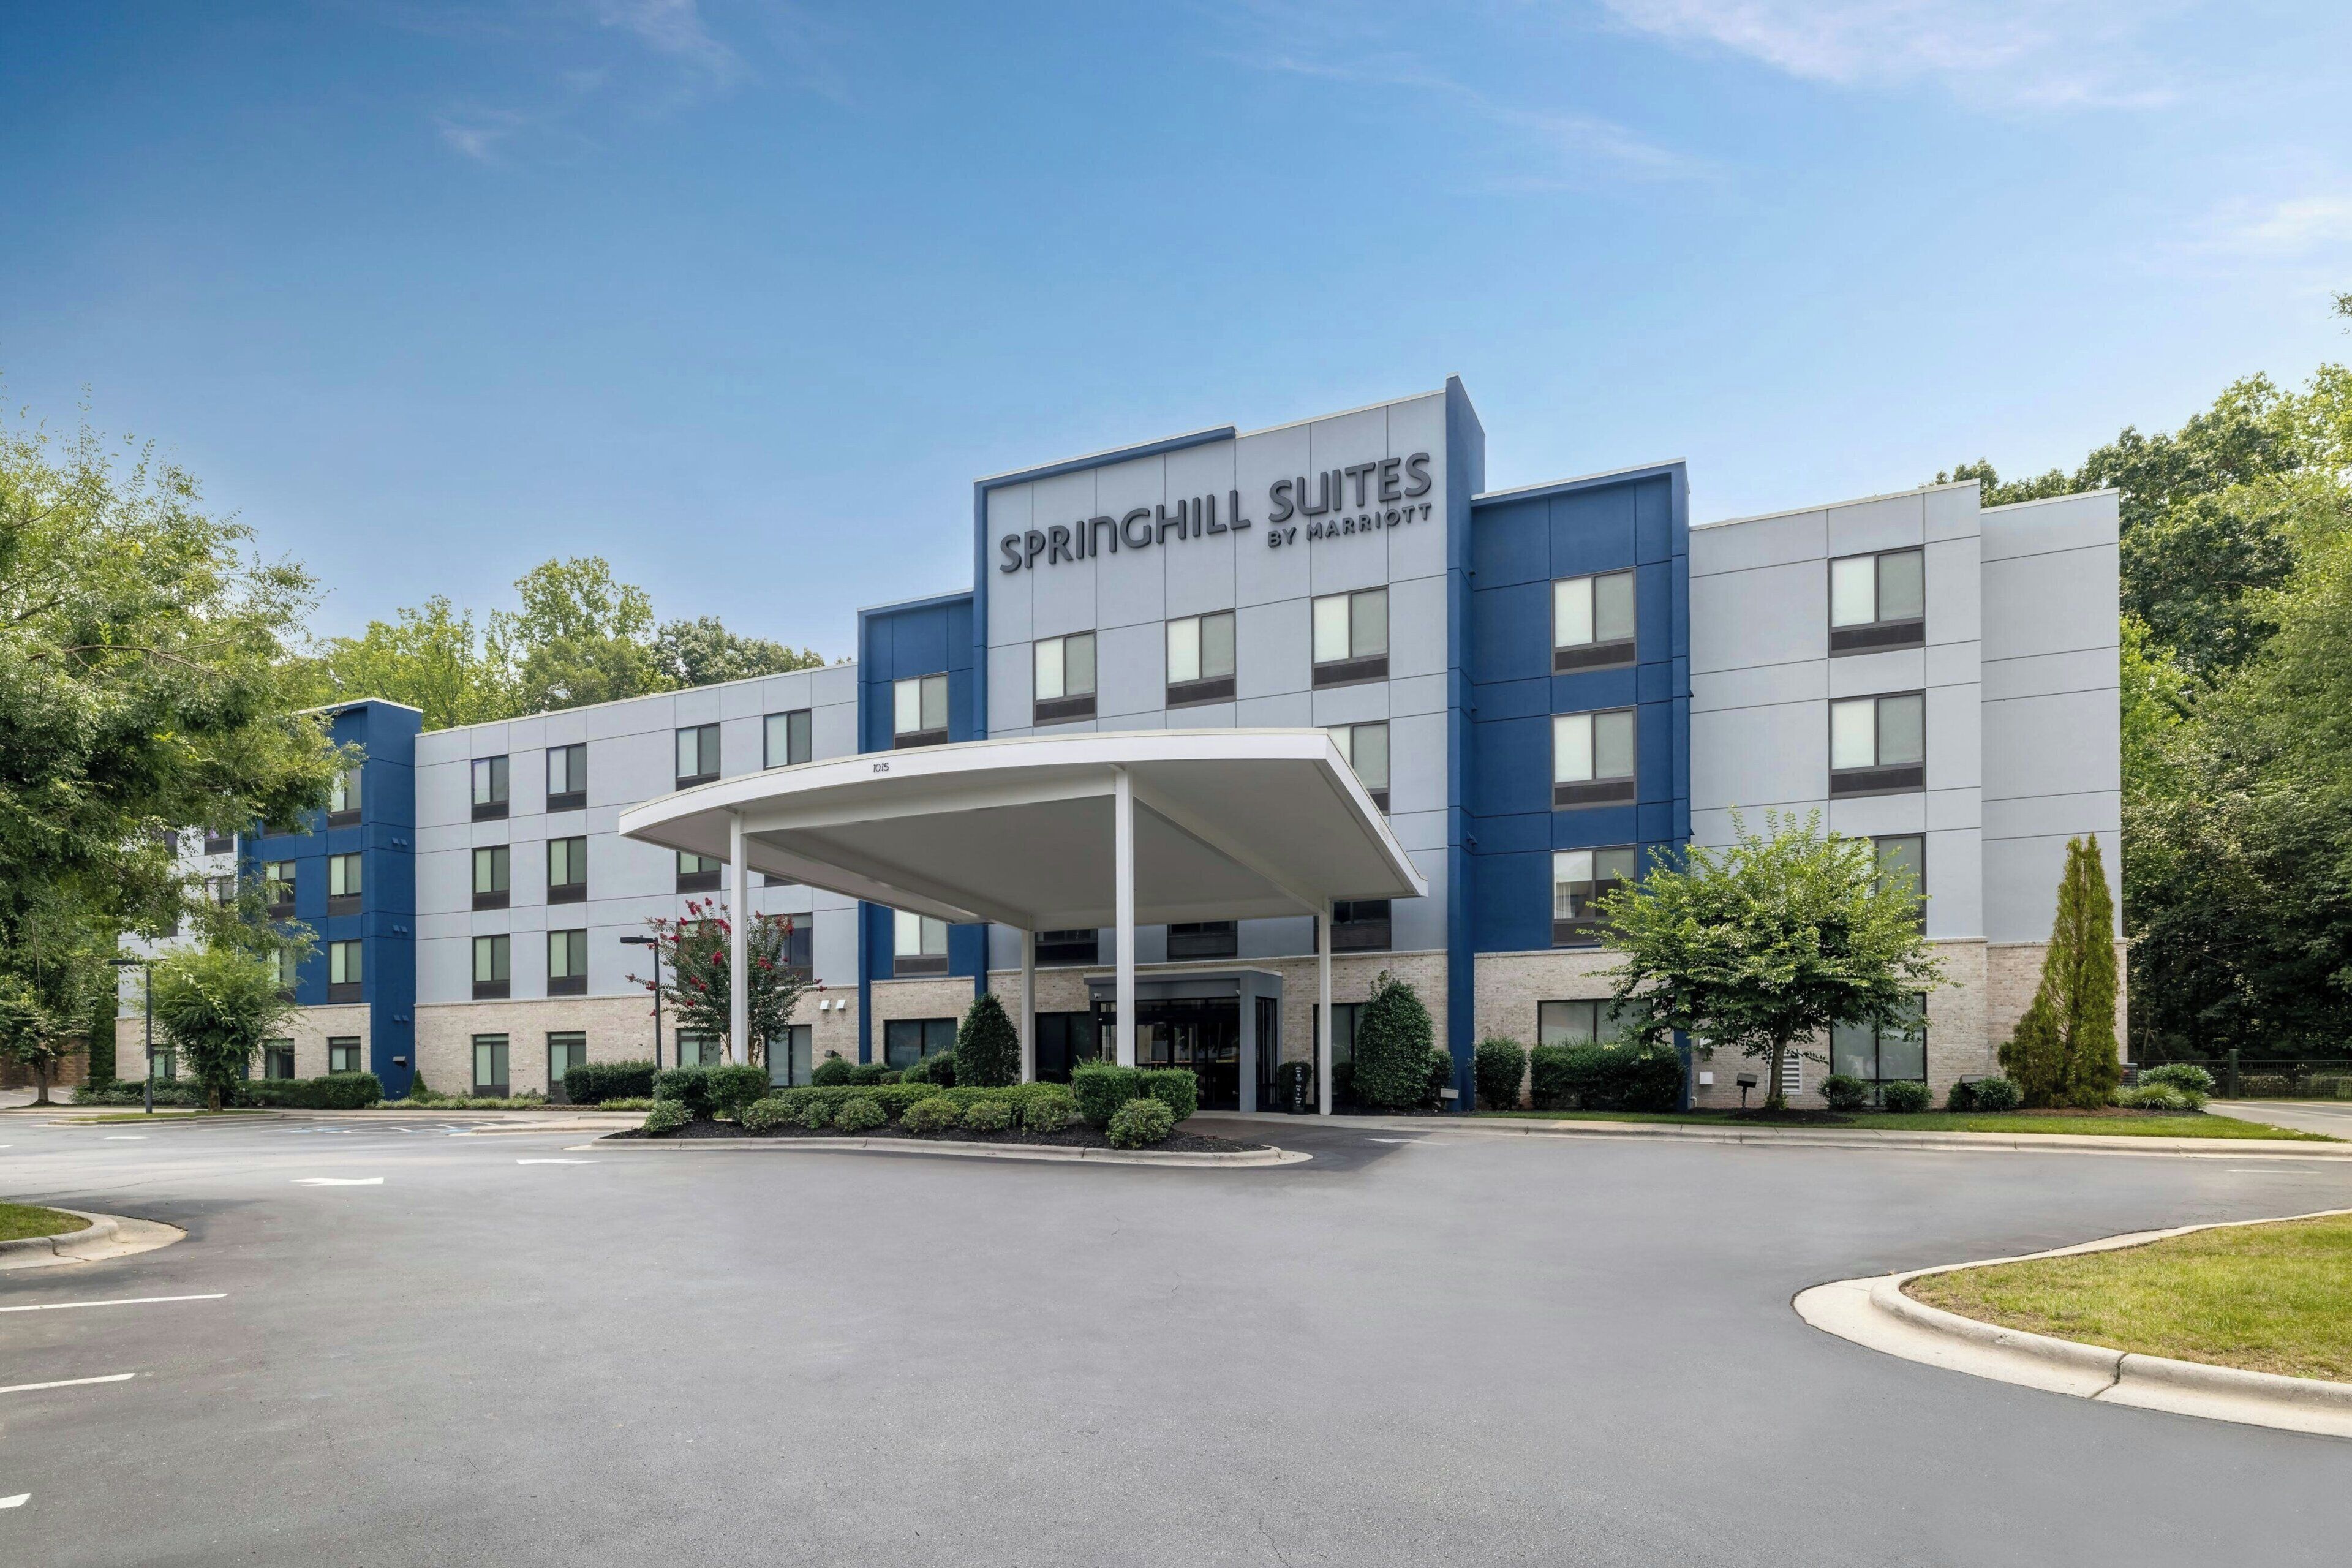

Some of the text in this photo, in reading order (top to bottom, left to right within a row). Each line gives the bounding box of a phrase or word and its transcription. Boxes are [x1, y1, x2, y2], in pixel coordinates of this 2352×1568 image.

[999, 452, 1431, 573] SPRINGHILL SUITES
[1268, 502, 1432, 548] BY MARRIOTT
[873, 763, 889, 772] 1015
